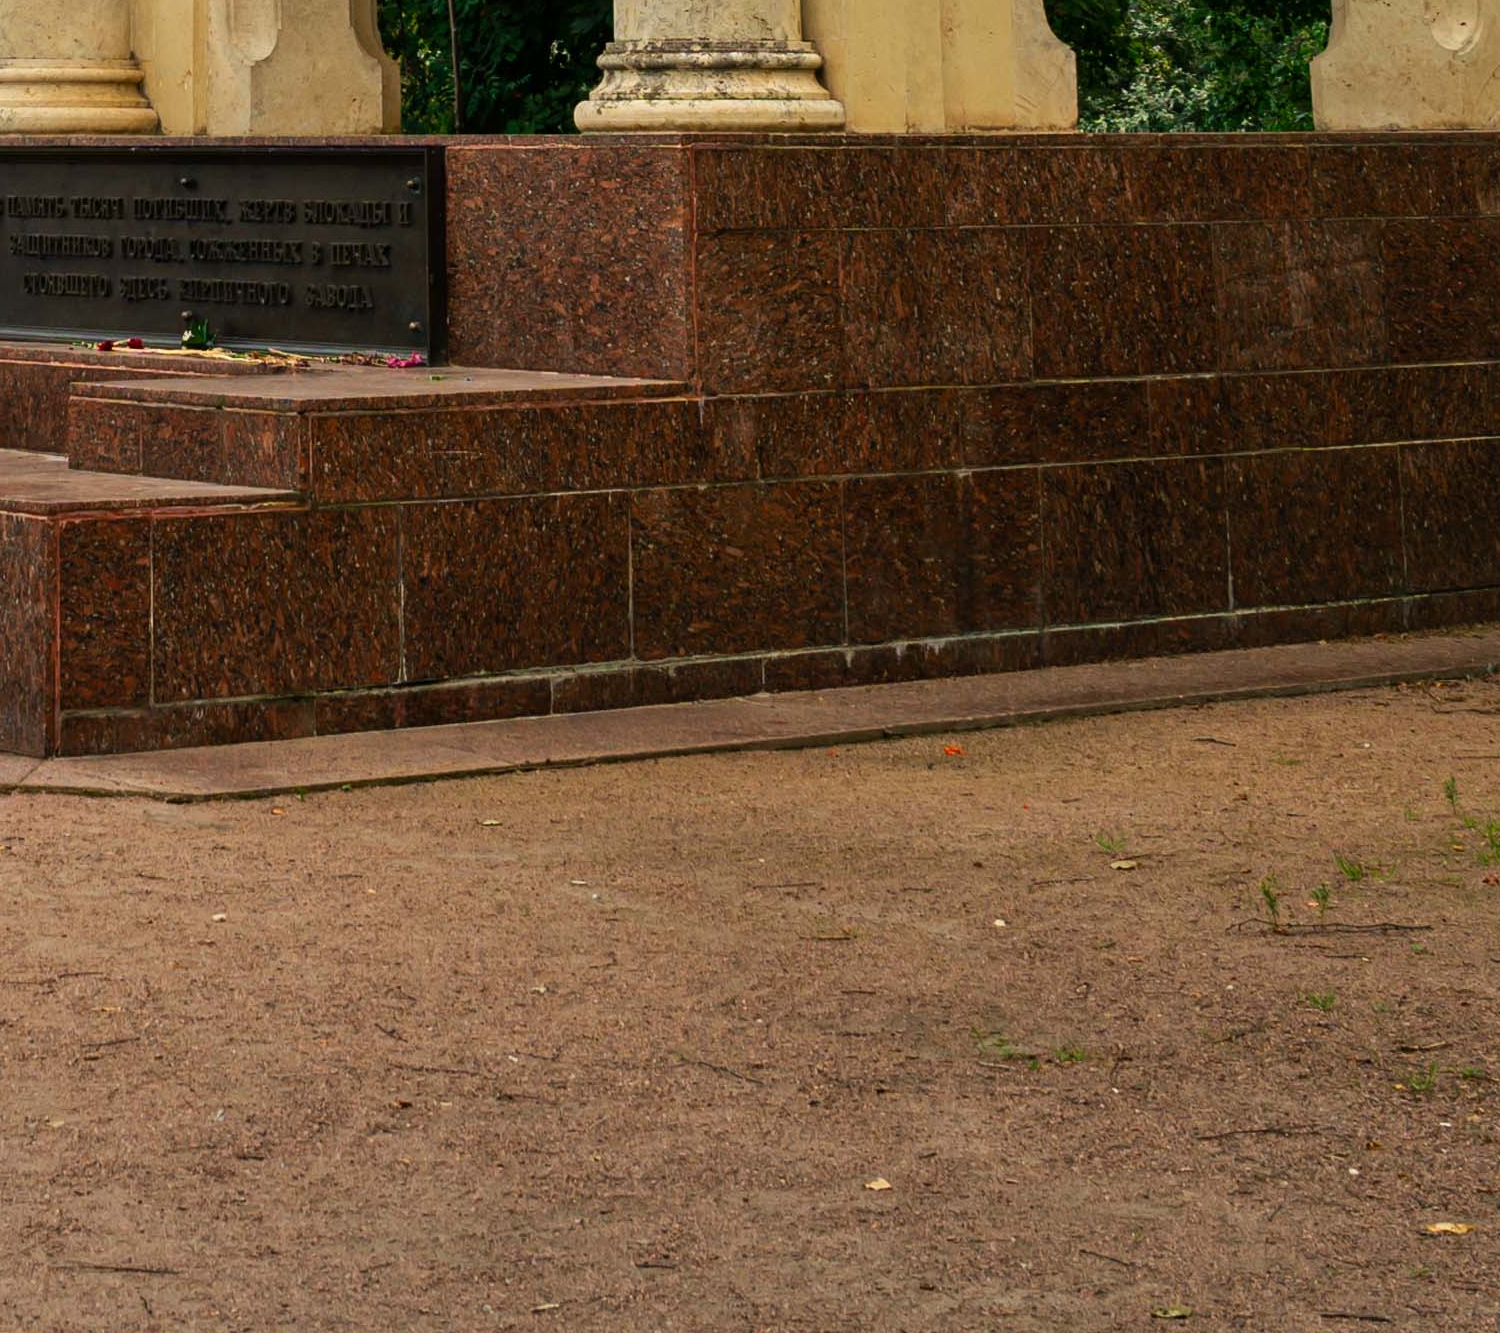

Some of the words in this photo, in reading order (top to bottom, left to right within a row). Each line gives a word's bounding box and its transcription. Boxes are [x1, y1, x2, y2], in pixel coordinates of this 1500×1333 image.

[7, 196, 67, 219] ПАМЯТЬ
[70, 197, 124, 220] ТЫСЯЧ
[239, 199, 297, 223] ЖЕРТВ
[303, 199, 392, 227] БЛОКАДЫ
[398, 201, 413, 226] И
[10, 233, 113, 257] ЗАЩИТНИКОВ
[312, 241, 324, 265] В
[329, 241, 391, 267] ПЕЧАХ
[23, 271, 112, 297] СТОЯВШЕГО
[120, 276, 170, 301] ЗДЕСЬ
[178, 277, 290, 305] КИРПИЧНОГО
[304, 284, 374, 309] ЗАВОДА
